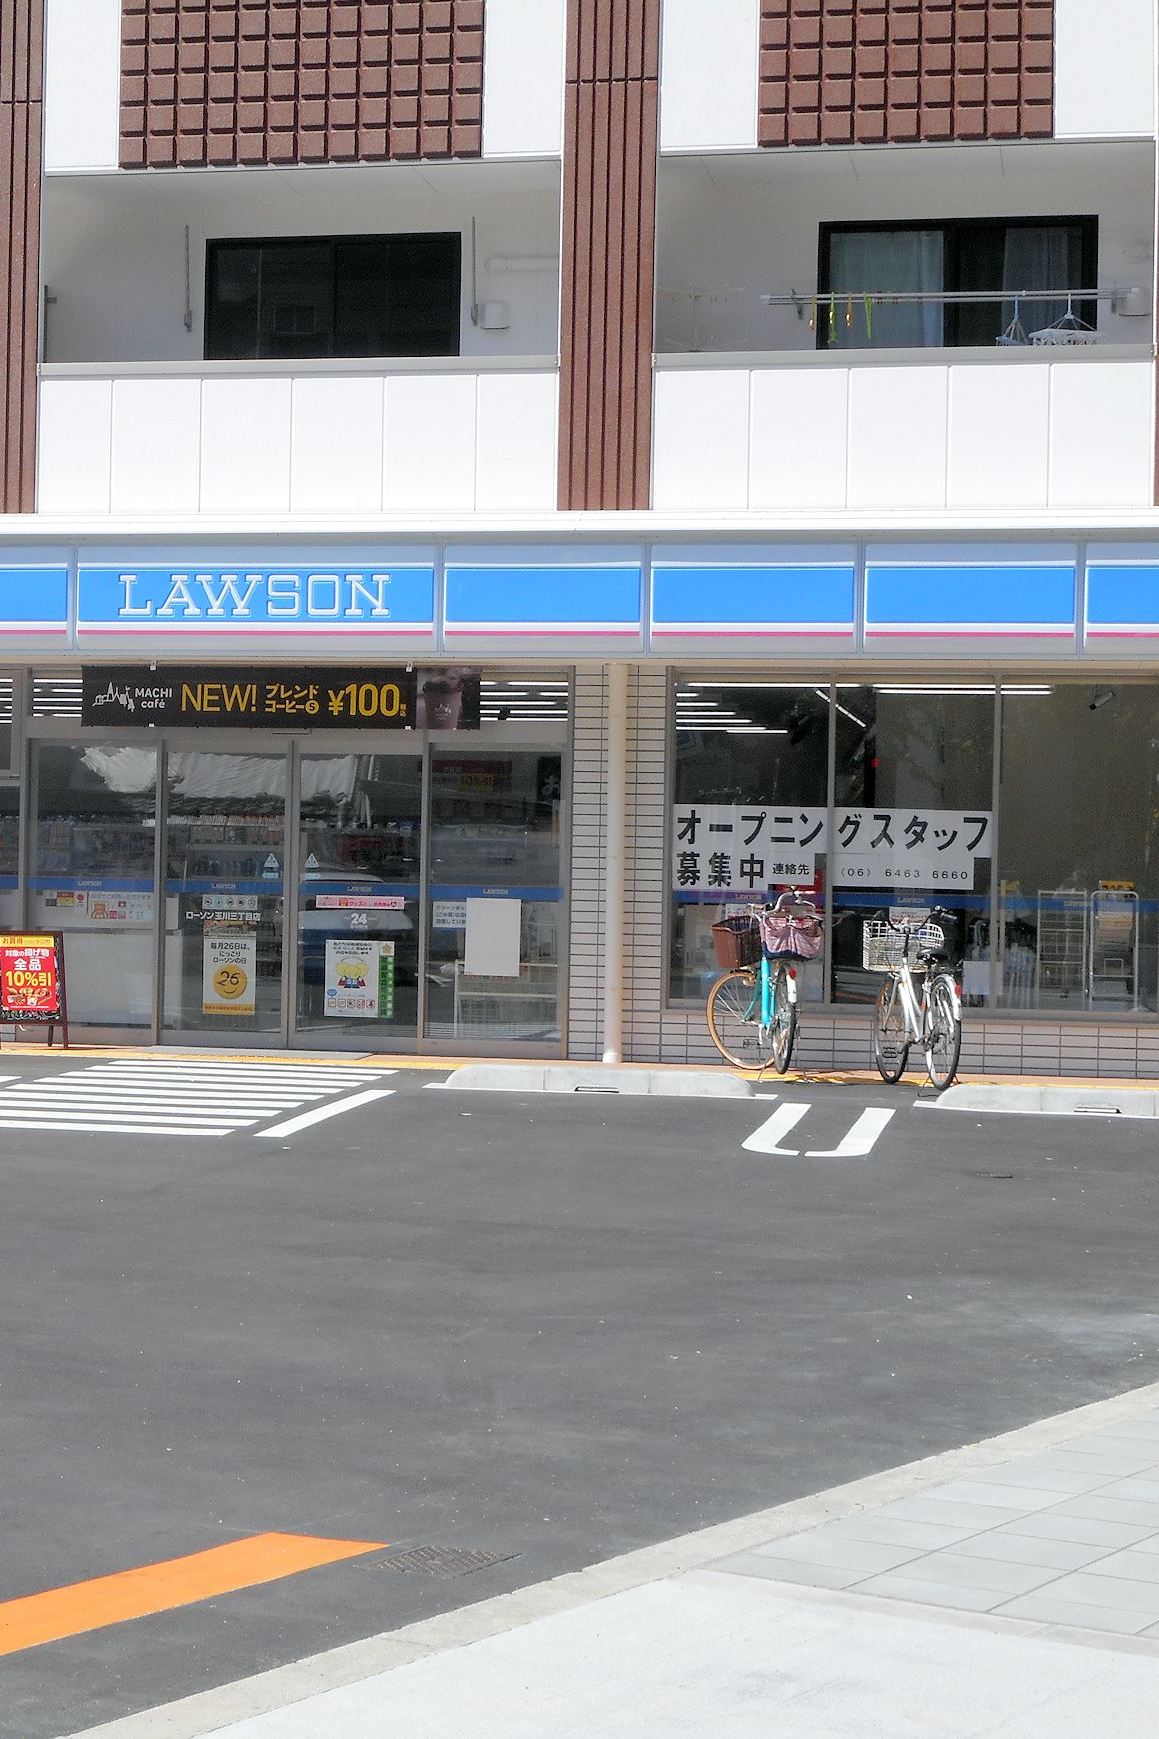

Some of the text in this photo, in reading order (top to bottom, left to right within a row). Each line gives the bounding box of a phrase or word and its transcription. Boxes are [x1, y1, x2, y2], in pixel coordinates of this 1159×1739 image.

[117, 574, 392, 617] LAWSON
[134, 687, 173, 698] MACHI
[181, 683, 257, 712] NEW!
[265, 683, 320, 699] ブレンド
[140, 698, 166, 709] café
[328, 683, 400, 717] ¥100
[676, 851, 810, 889] 募集中 連絡先
[841, 868, 968, 880] (06) 6463 6660
[186, 911, 261, 921] ローソン玉川三丁目店
[351, 912, 368, 925] 24
[13, 957, 42, 971] 全品
[5, 970, 52, 987] 10%引
[216, 970, 241, 987] 26
